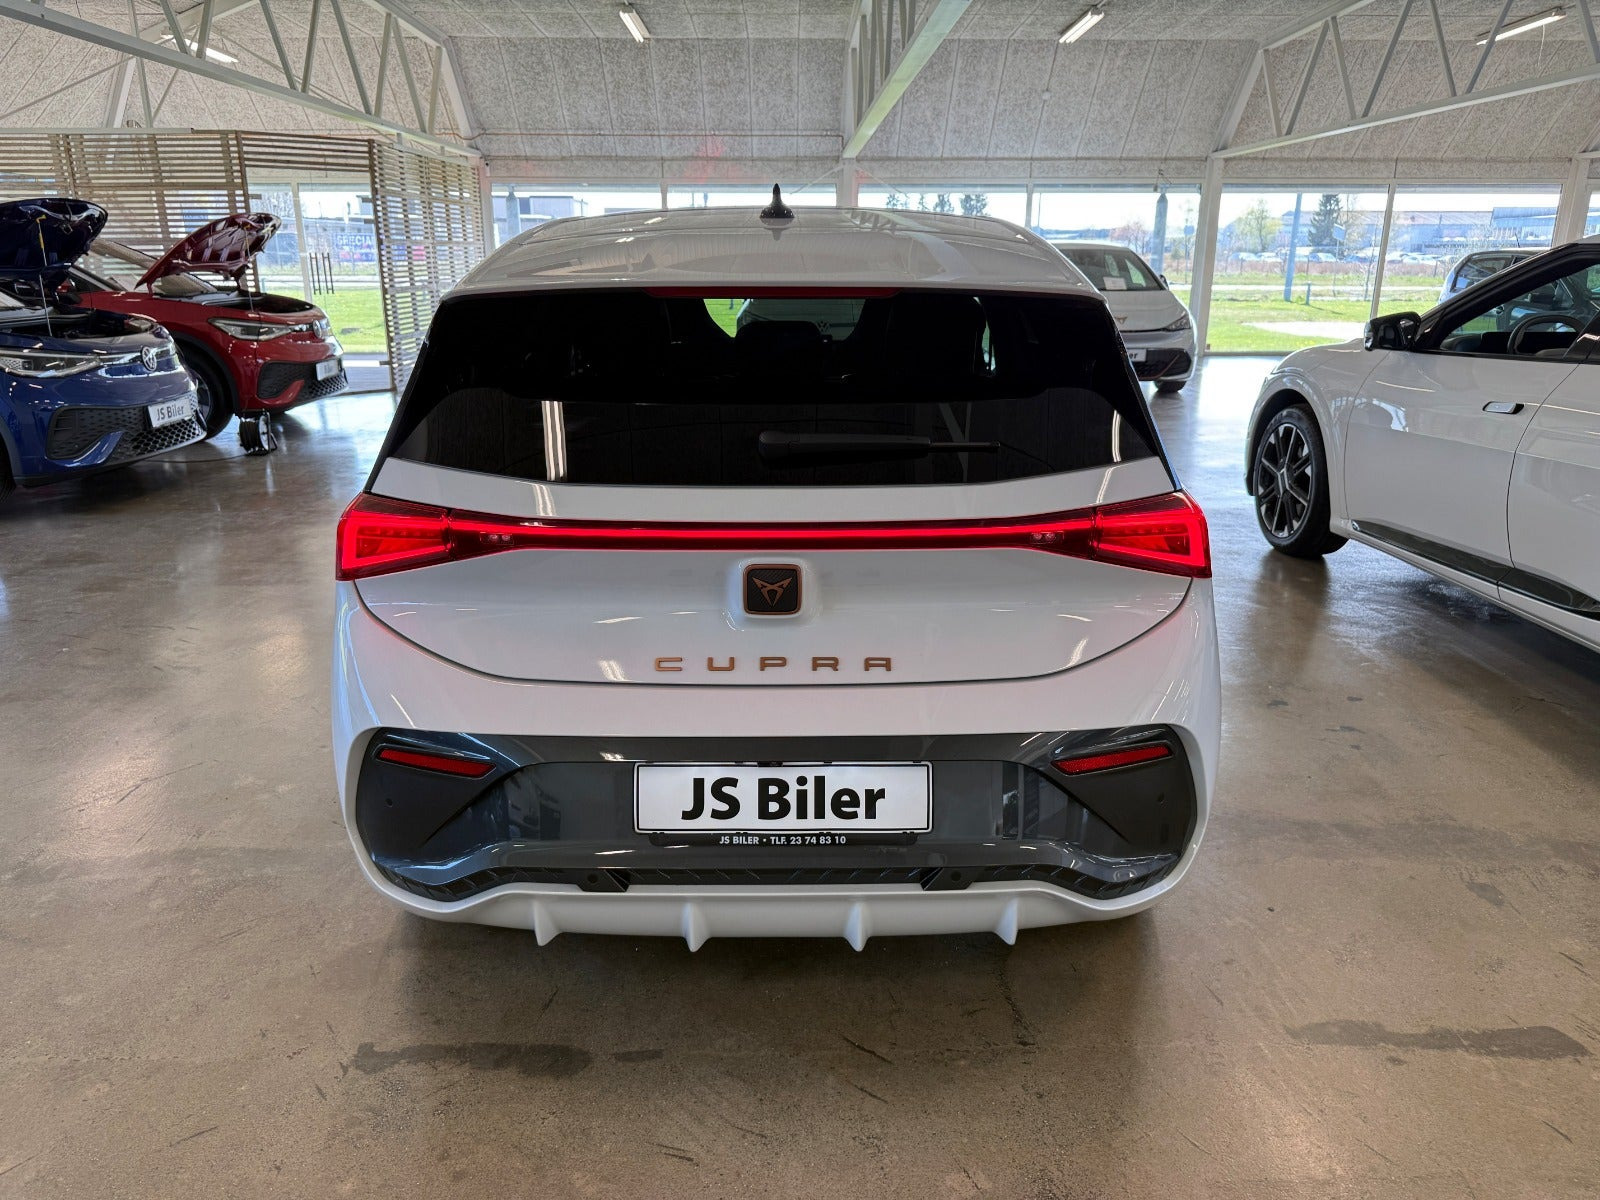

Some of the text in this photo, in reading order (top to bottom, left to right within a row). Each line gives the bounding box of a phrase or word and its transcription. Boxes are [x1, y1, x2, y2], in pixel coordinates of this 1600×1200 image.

[157, 404, 184, 421] JS Biler
[655, 656, 892, 672] CUPRA
[681, 775, 886, 820] JS Biler
[719, 835, 730, 844] JS
[732, 836, 759, 845] BILER
[789, 836, 802, 845] 23
[805, 836, 817, 845] 74
[820, 835, 832, 844] 83
[835, 835, 847, 844] 10
